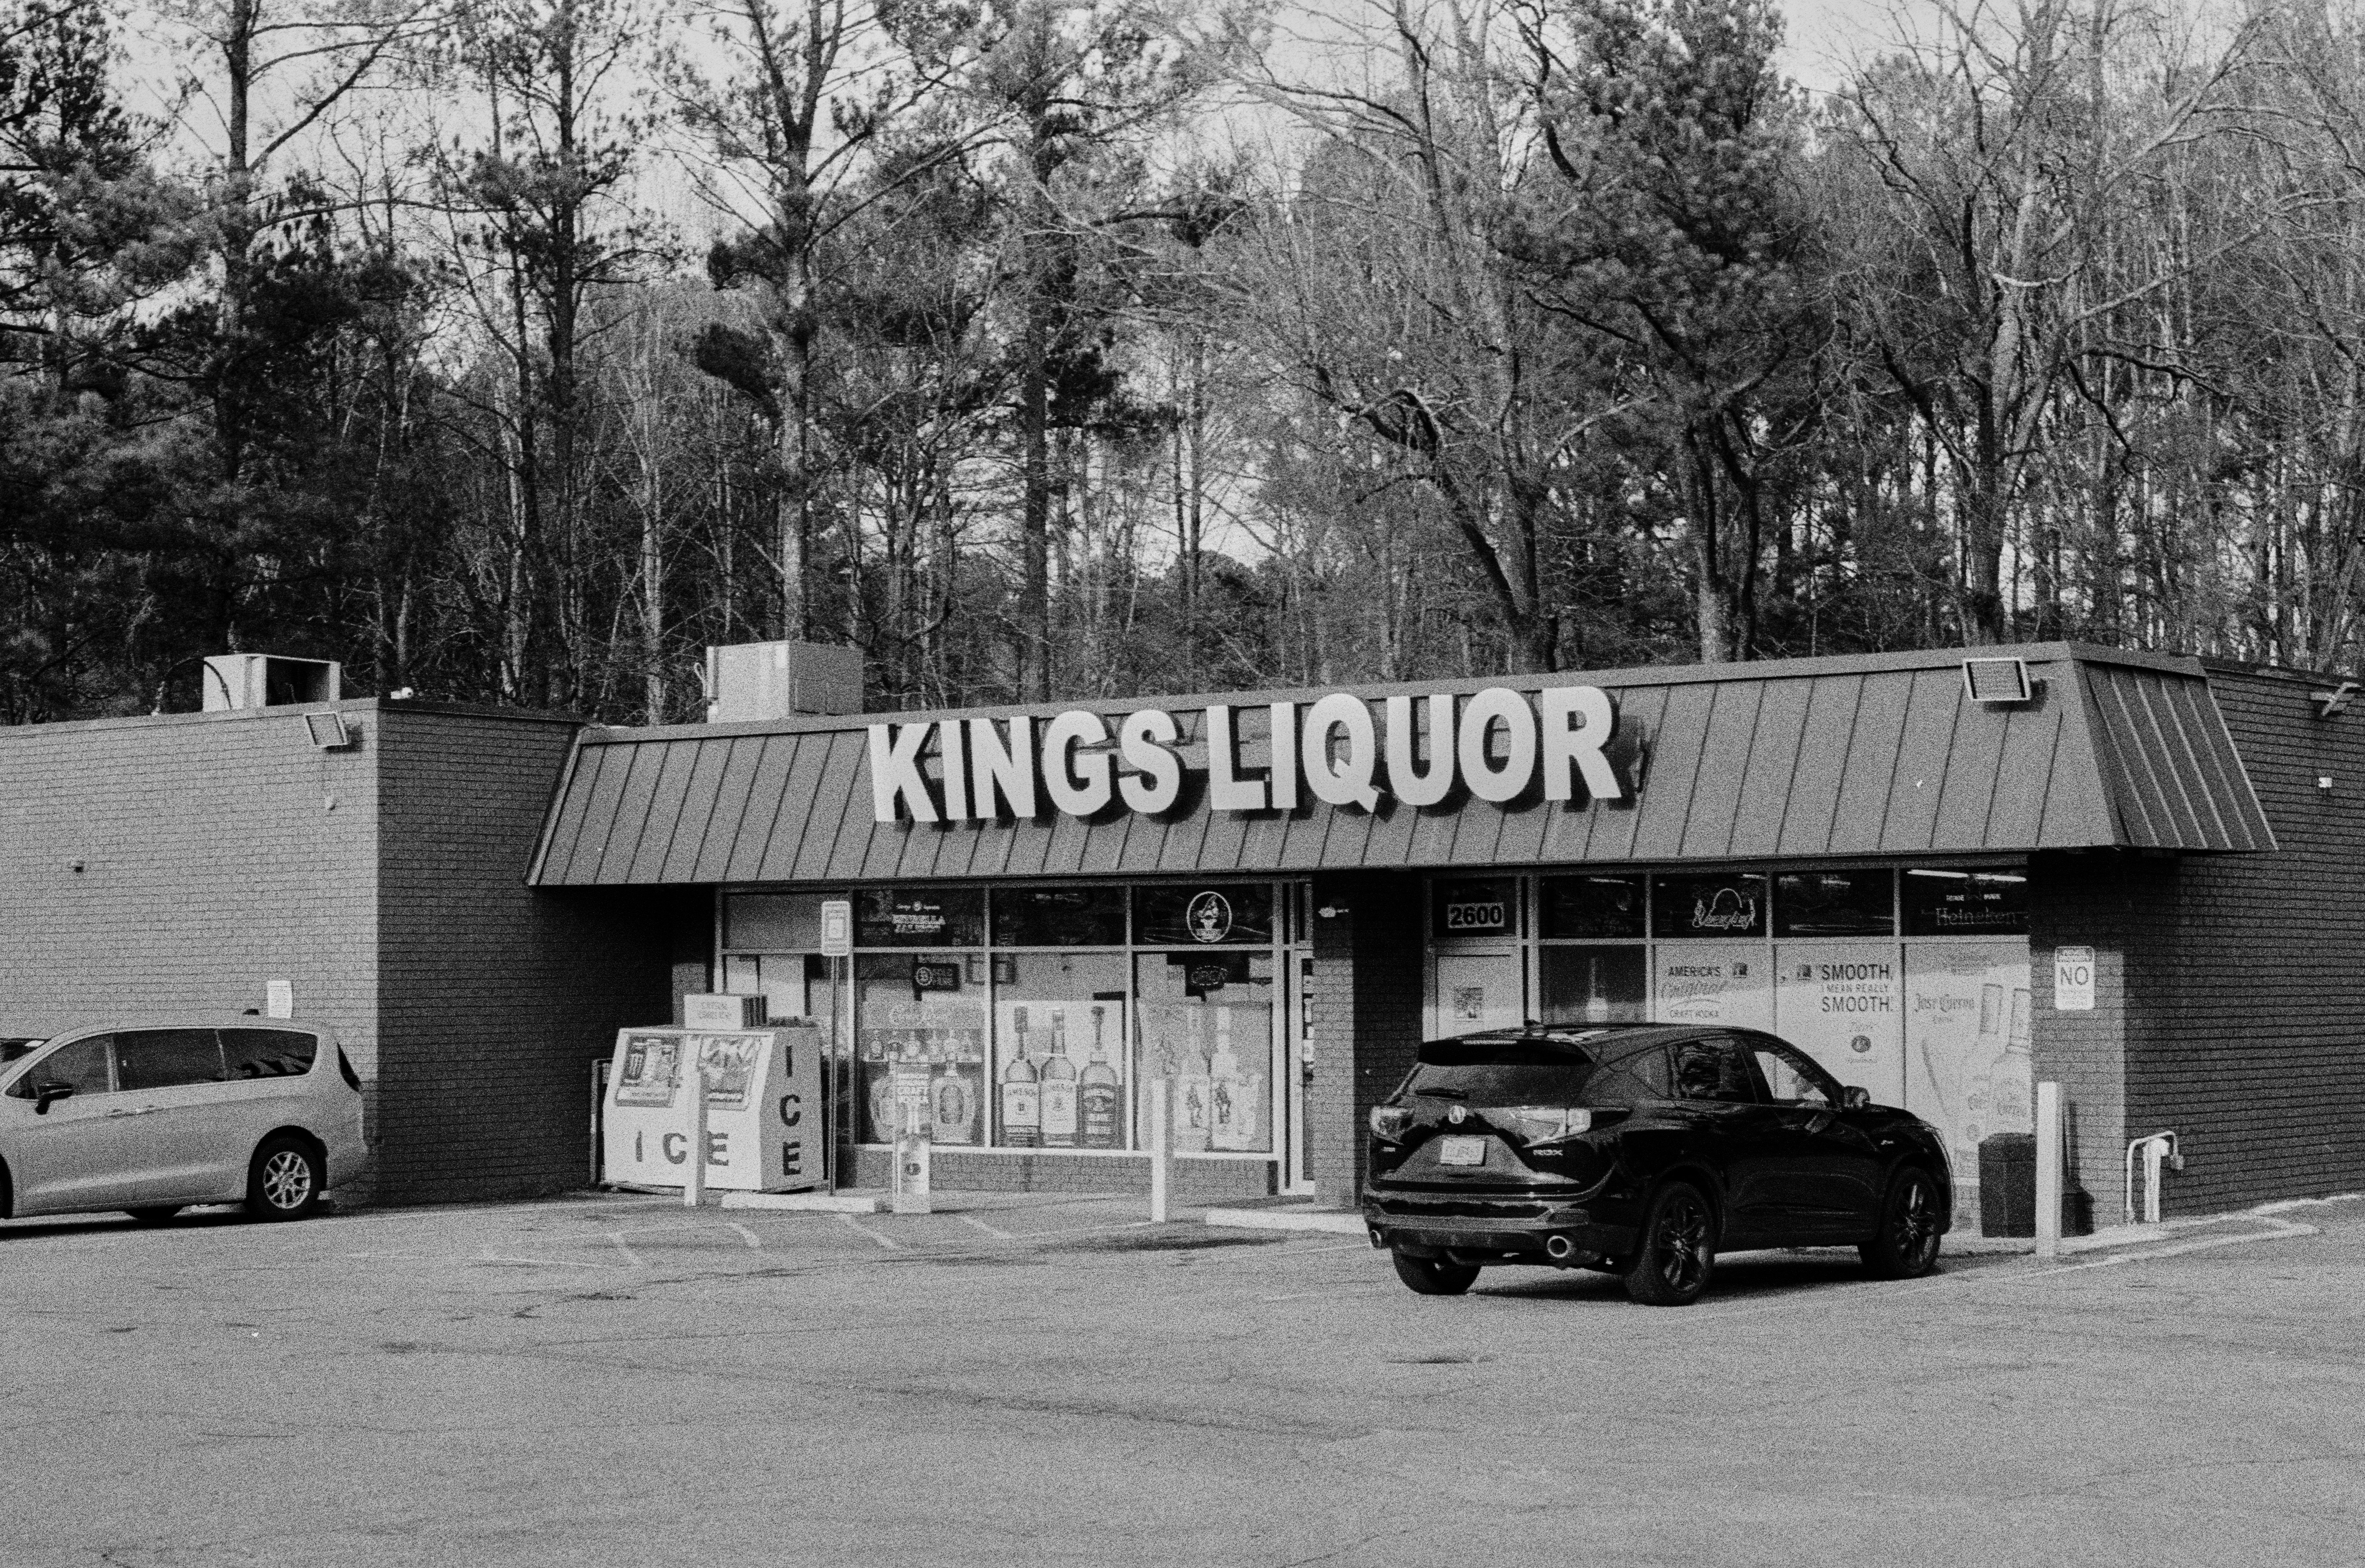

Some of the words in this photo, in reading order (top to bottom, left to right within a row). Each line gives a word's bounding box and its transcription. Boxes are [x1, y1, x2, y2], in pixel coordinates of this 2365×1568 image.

[868, 709, 1180, 822] KINGS
[1207, 685, 1621, 813] LIQUOR
[1450, 905, 1502, 925] 2600
[1936, 907, 2017, 926] Heineken
[1668, 965, 1721, 977] AMERICA'S
[2060, 965, 2089, 986] NO
[1827, 983, 1852, 993] MEAN
[779, 1045, 801, 1176] ICE
[636, 1130, 729, 1167] ICE
